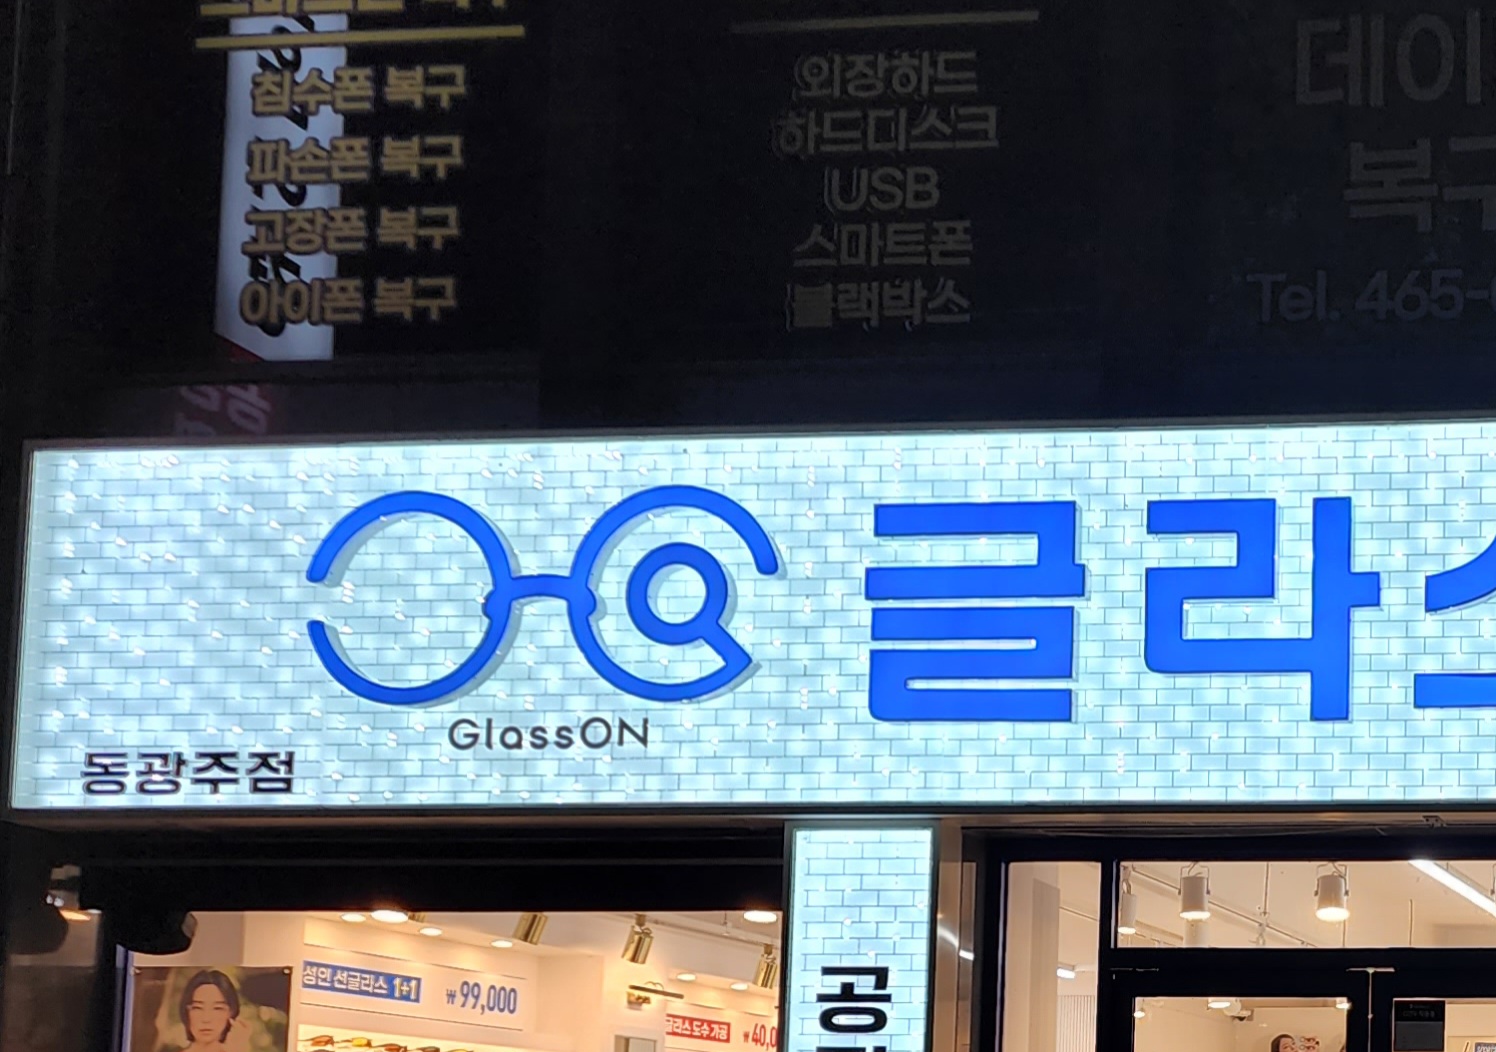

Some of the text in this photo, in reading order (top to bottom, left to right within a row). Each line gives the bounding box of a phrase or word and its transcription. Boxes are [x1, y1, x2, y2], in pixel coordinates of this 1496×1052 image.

[251, 63, 466, 115] 침수폰 복구
[795, 50, 978, 98] 외장하드
[777, 105, 999, 156] 하드디스크
[247, 135, 464, 185] 파손폰 복구
[825, 166, 940, 212] USB
[242, 205, 461, 255] 고장폰 복구
[793, 220, 973, 267] 스마트폰
[240, 276, 458, 325] 아이폰 복구
[1247, 271, 1339, 322] Tel.
[448, 716, 650, 751] GlassON
[80, 751, 295, 795] 동광주점
[302, 965, 418, 1001] 성인 선글라스 1+1
